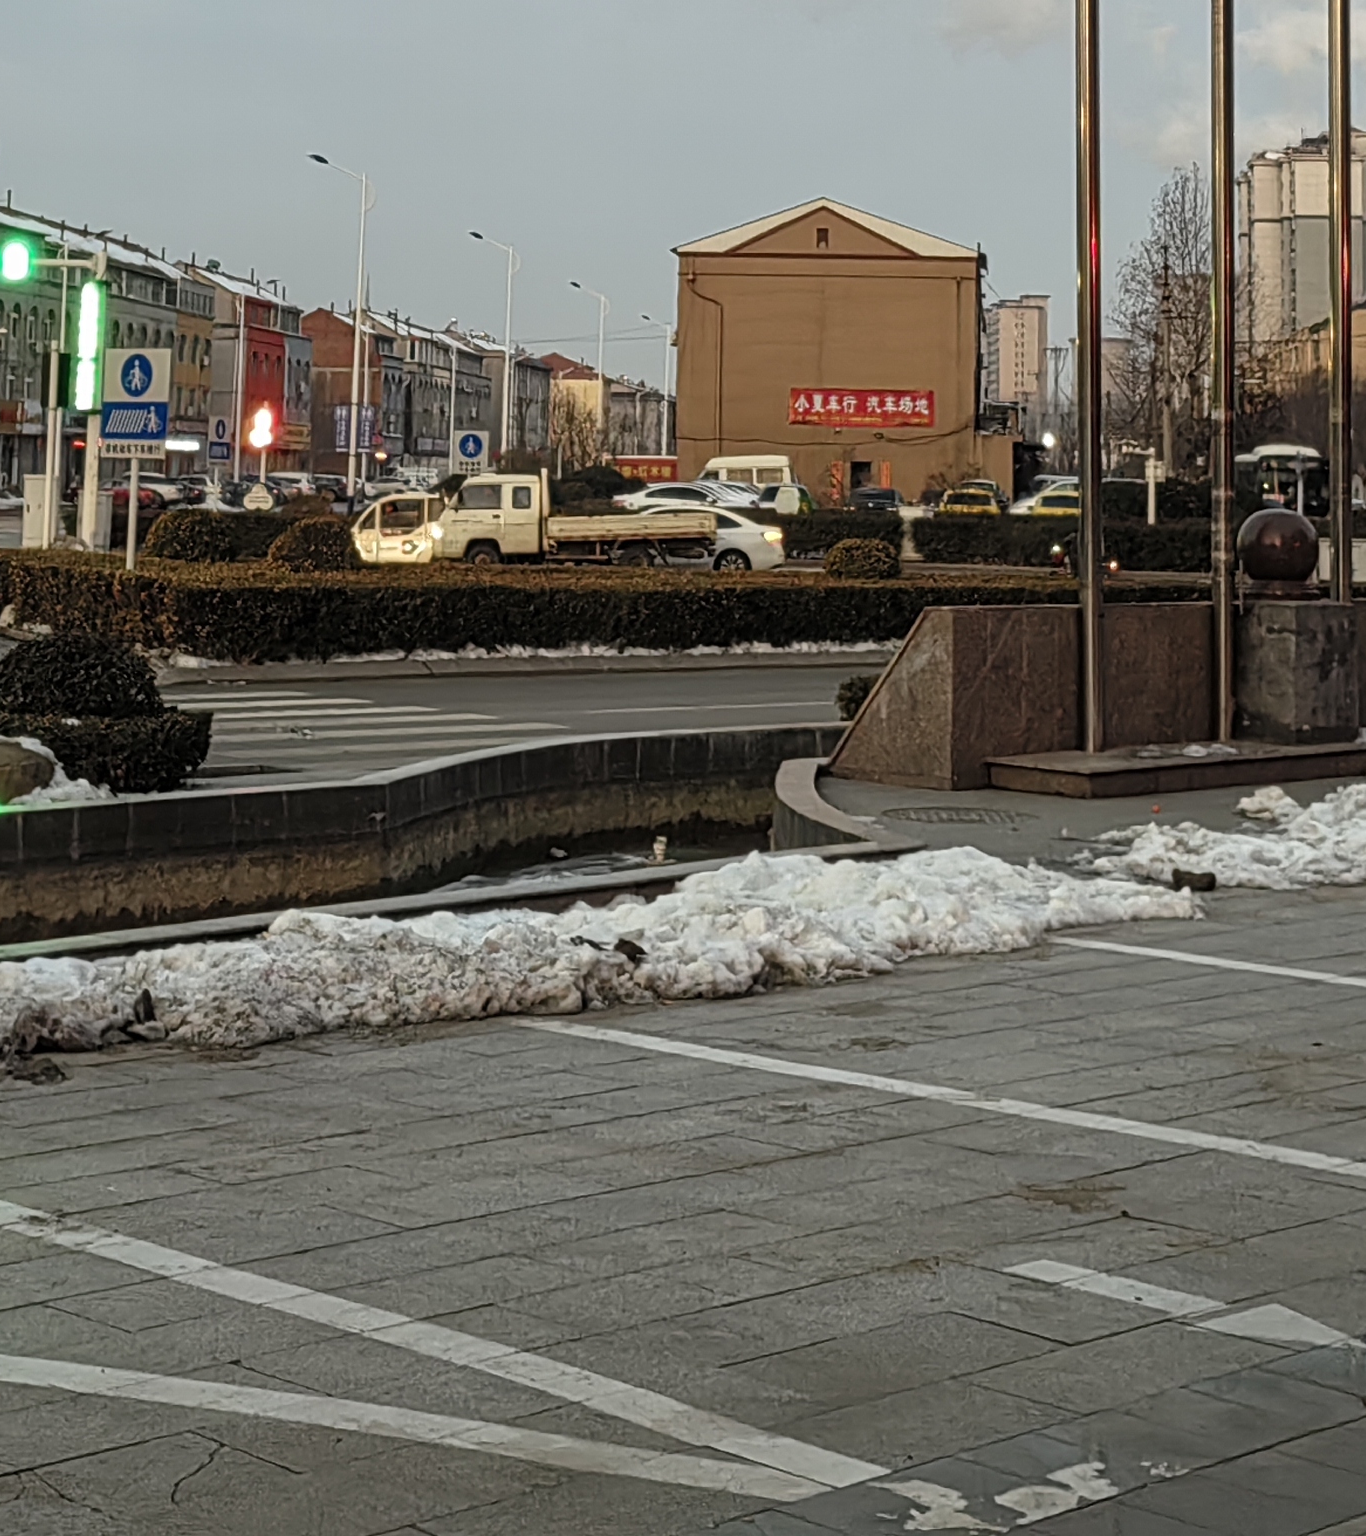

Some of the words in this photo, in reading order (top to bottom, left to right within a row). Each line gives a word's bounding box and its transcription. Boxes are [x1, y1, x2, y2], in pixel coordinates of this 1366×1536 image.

[794, 393, 858, 413] 小夏车行
[866, 396, 930, 415] 汽车场地
